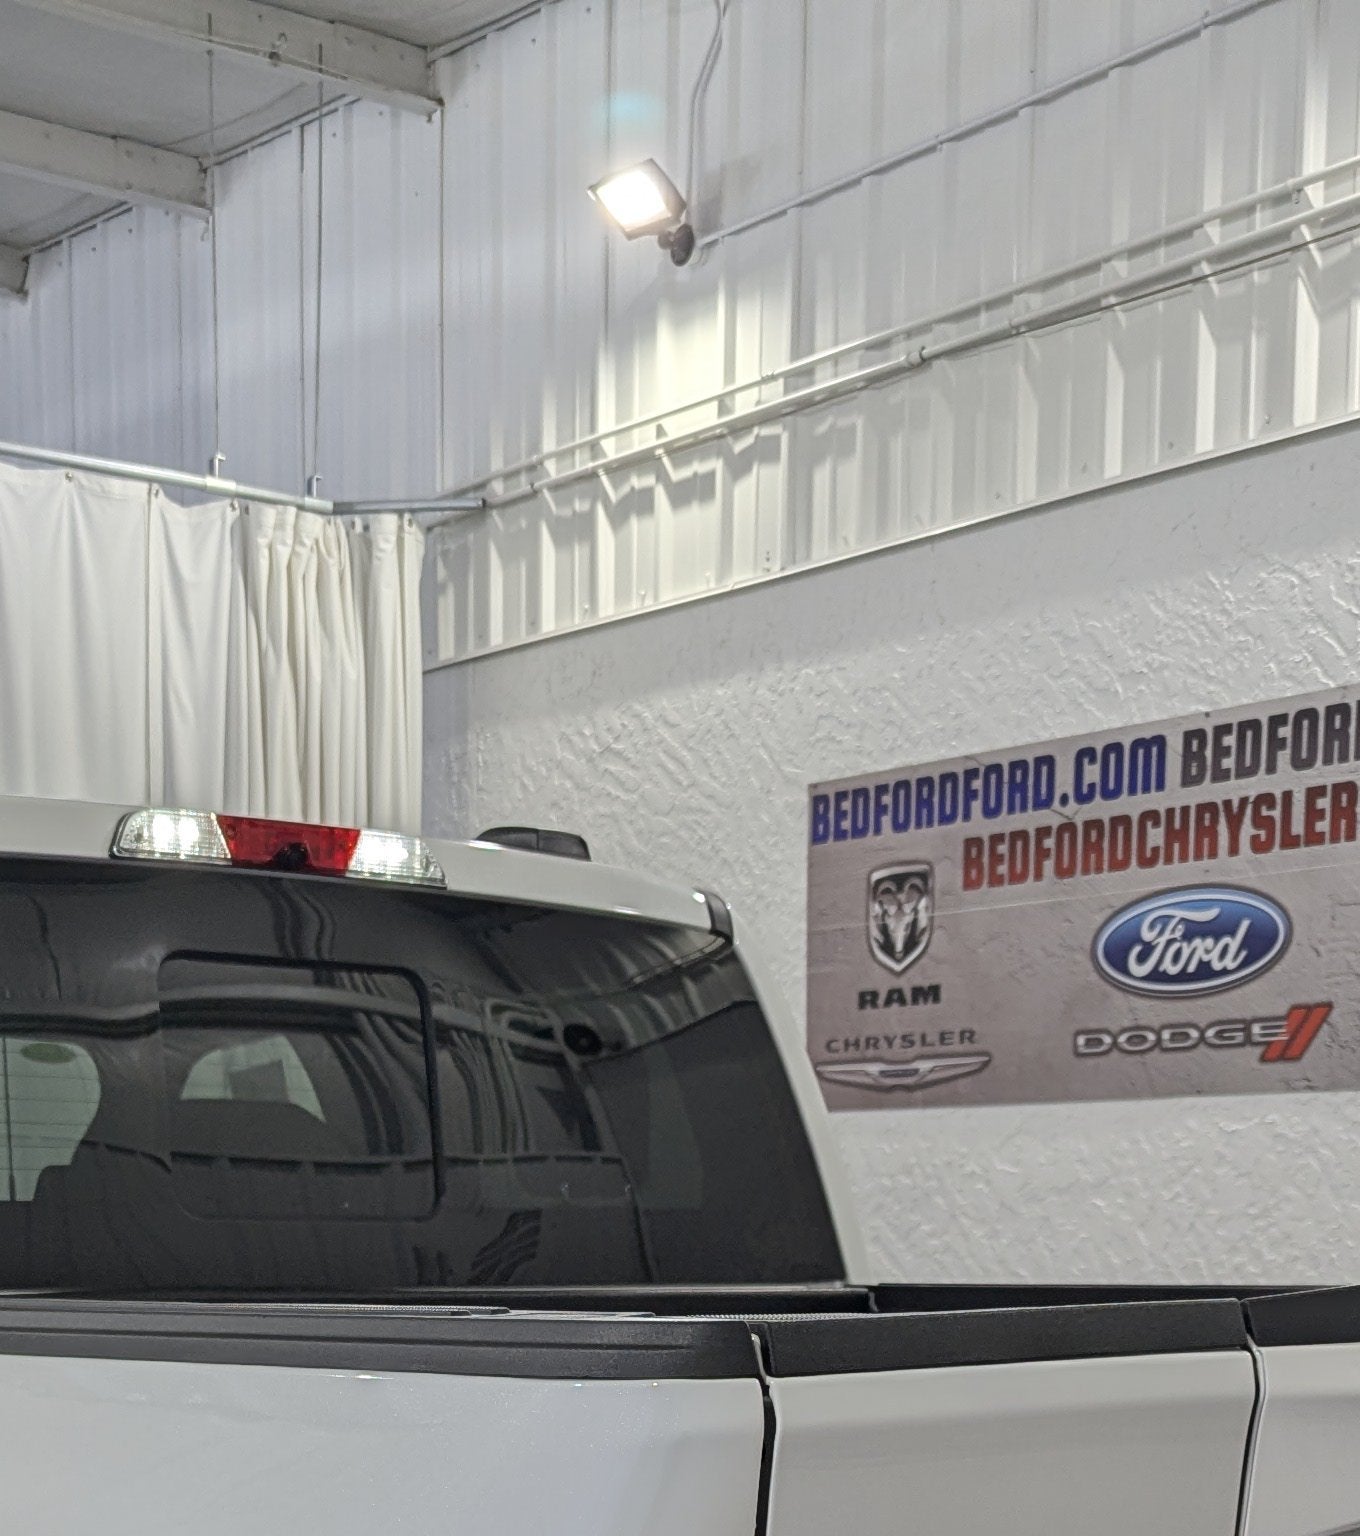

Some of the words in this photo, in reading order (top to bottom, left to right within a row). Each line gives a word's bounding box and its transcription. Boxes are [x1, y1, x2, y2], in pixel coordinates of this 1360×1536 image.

[811, 734, 1167, 846] BEDFORDFORD.COM
[1127, 907, 1251, 978] Ford
[857, 983, 942, 1010] RAM
[825, 1029, 977, 1054] CHRYSLER
[1074, 1016, 1292, 1057] DODGE
